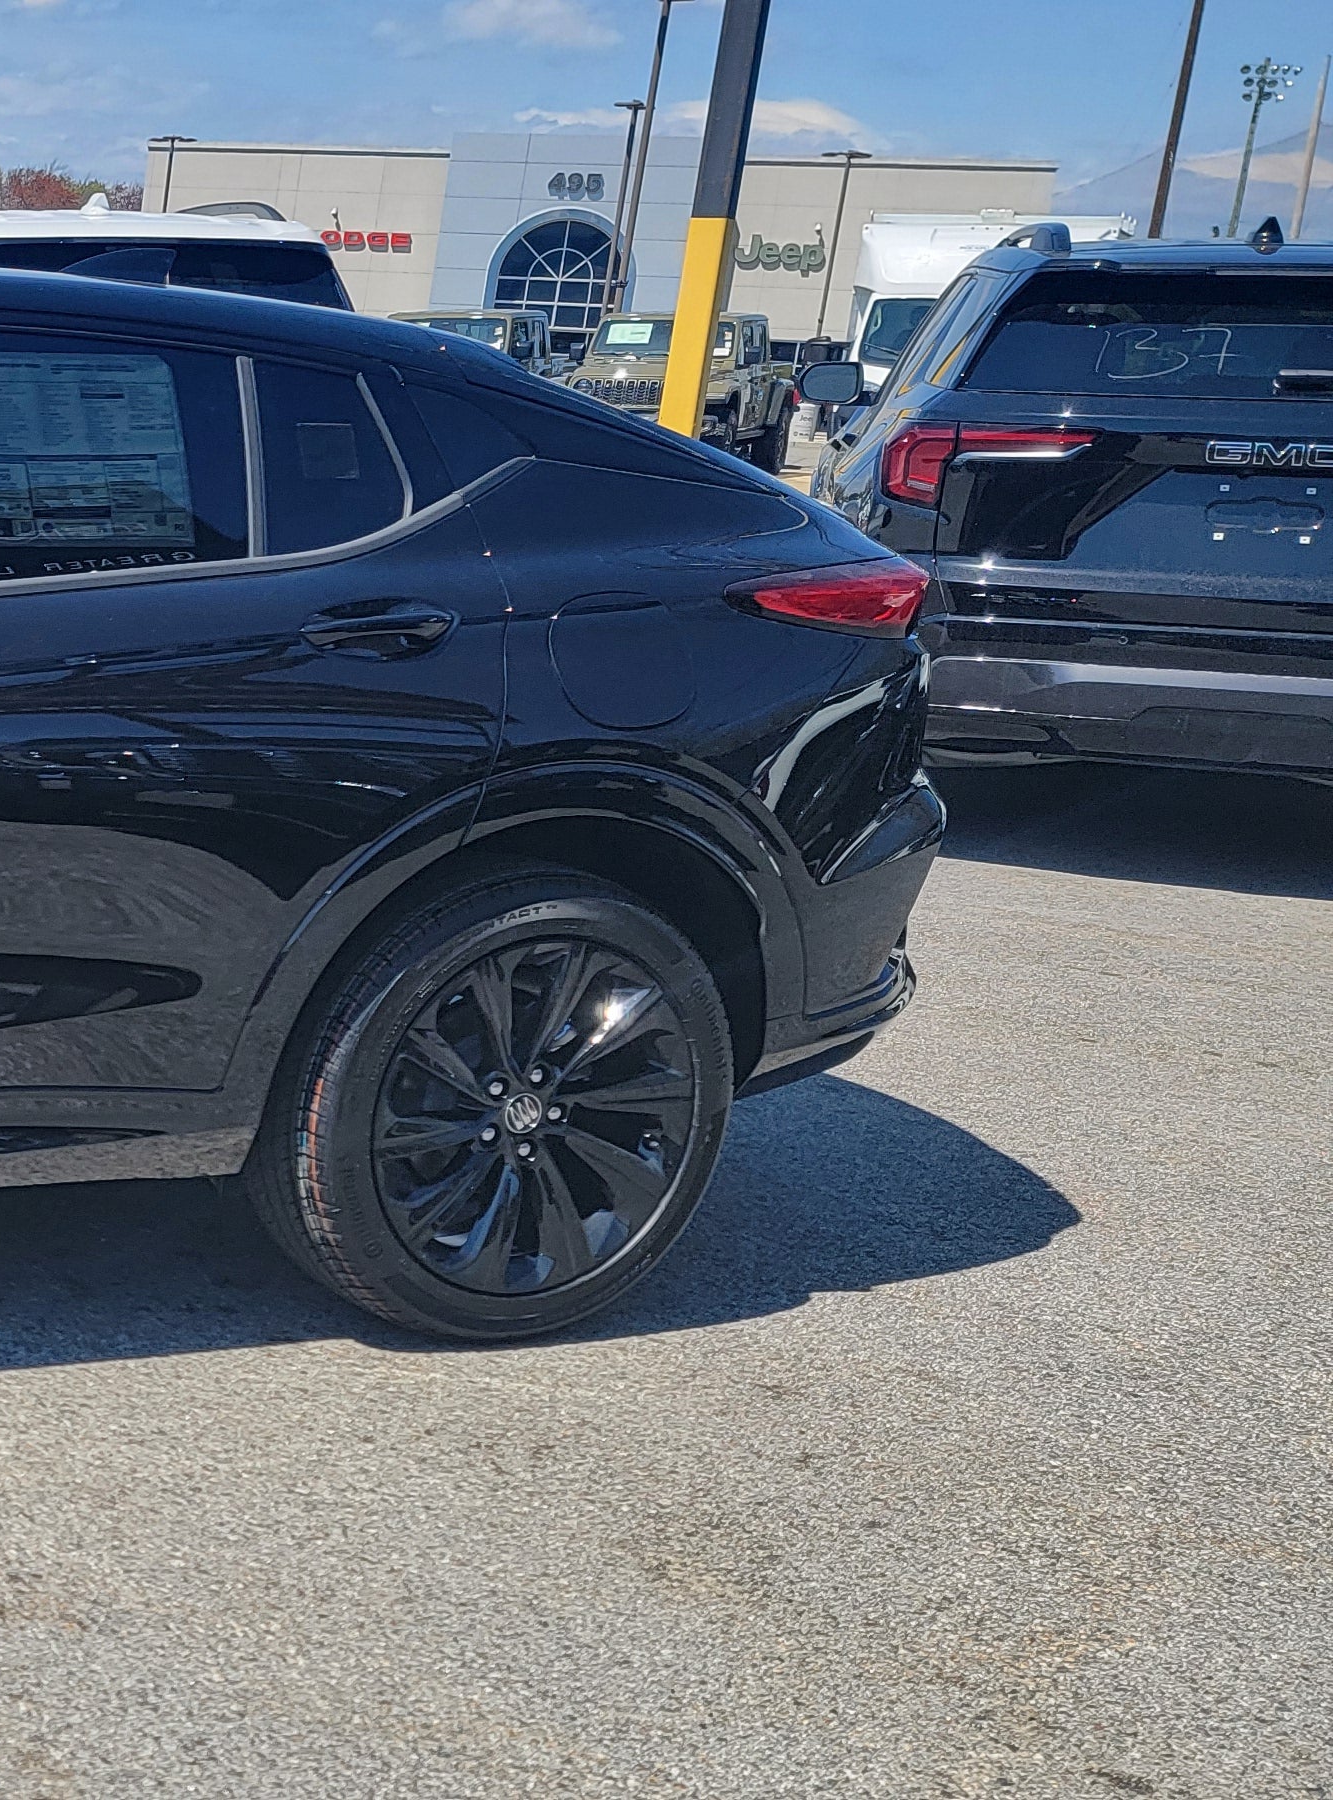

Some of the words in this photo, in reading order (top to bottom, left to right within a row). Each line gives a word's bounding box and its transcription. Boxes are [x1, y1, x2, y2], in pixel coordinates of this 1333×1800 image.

[547, 172, 604, 199] 495
[735, 234, 825, 274] Jeep
[1205, 441, 1333, 468] GMC
